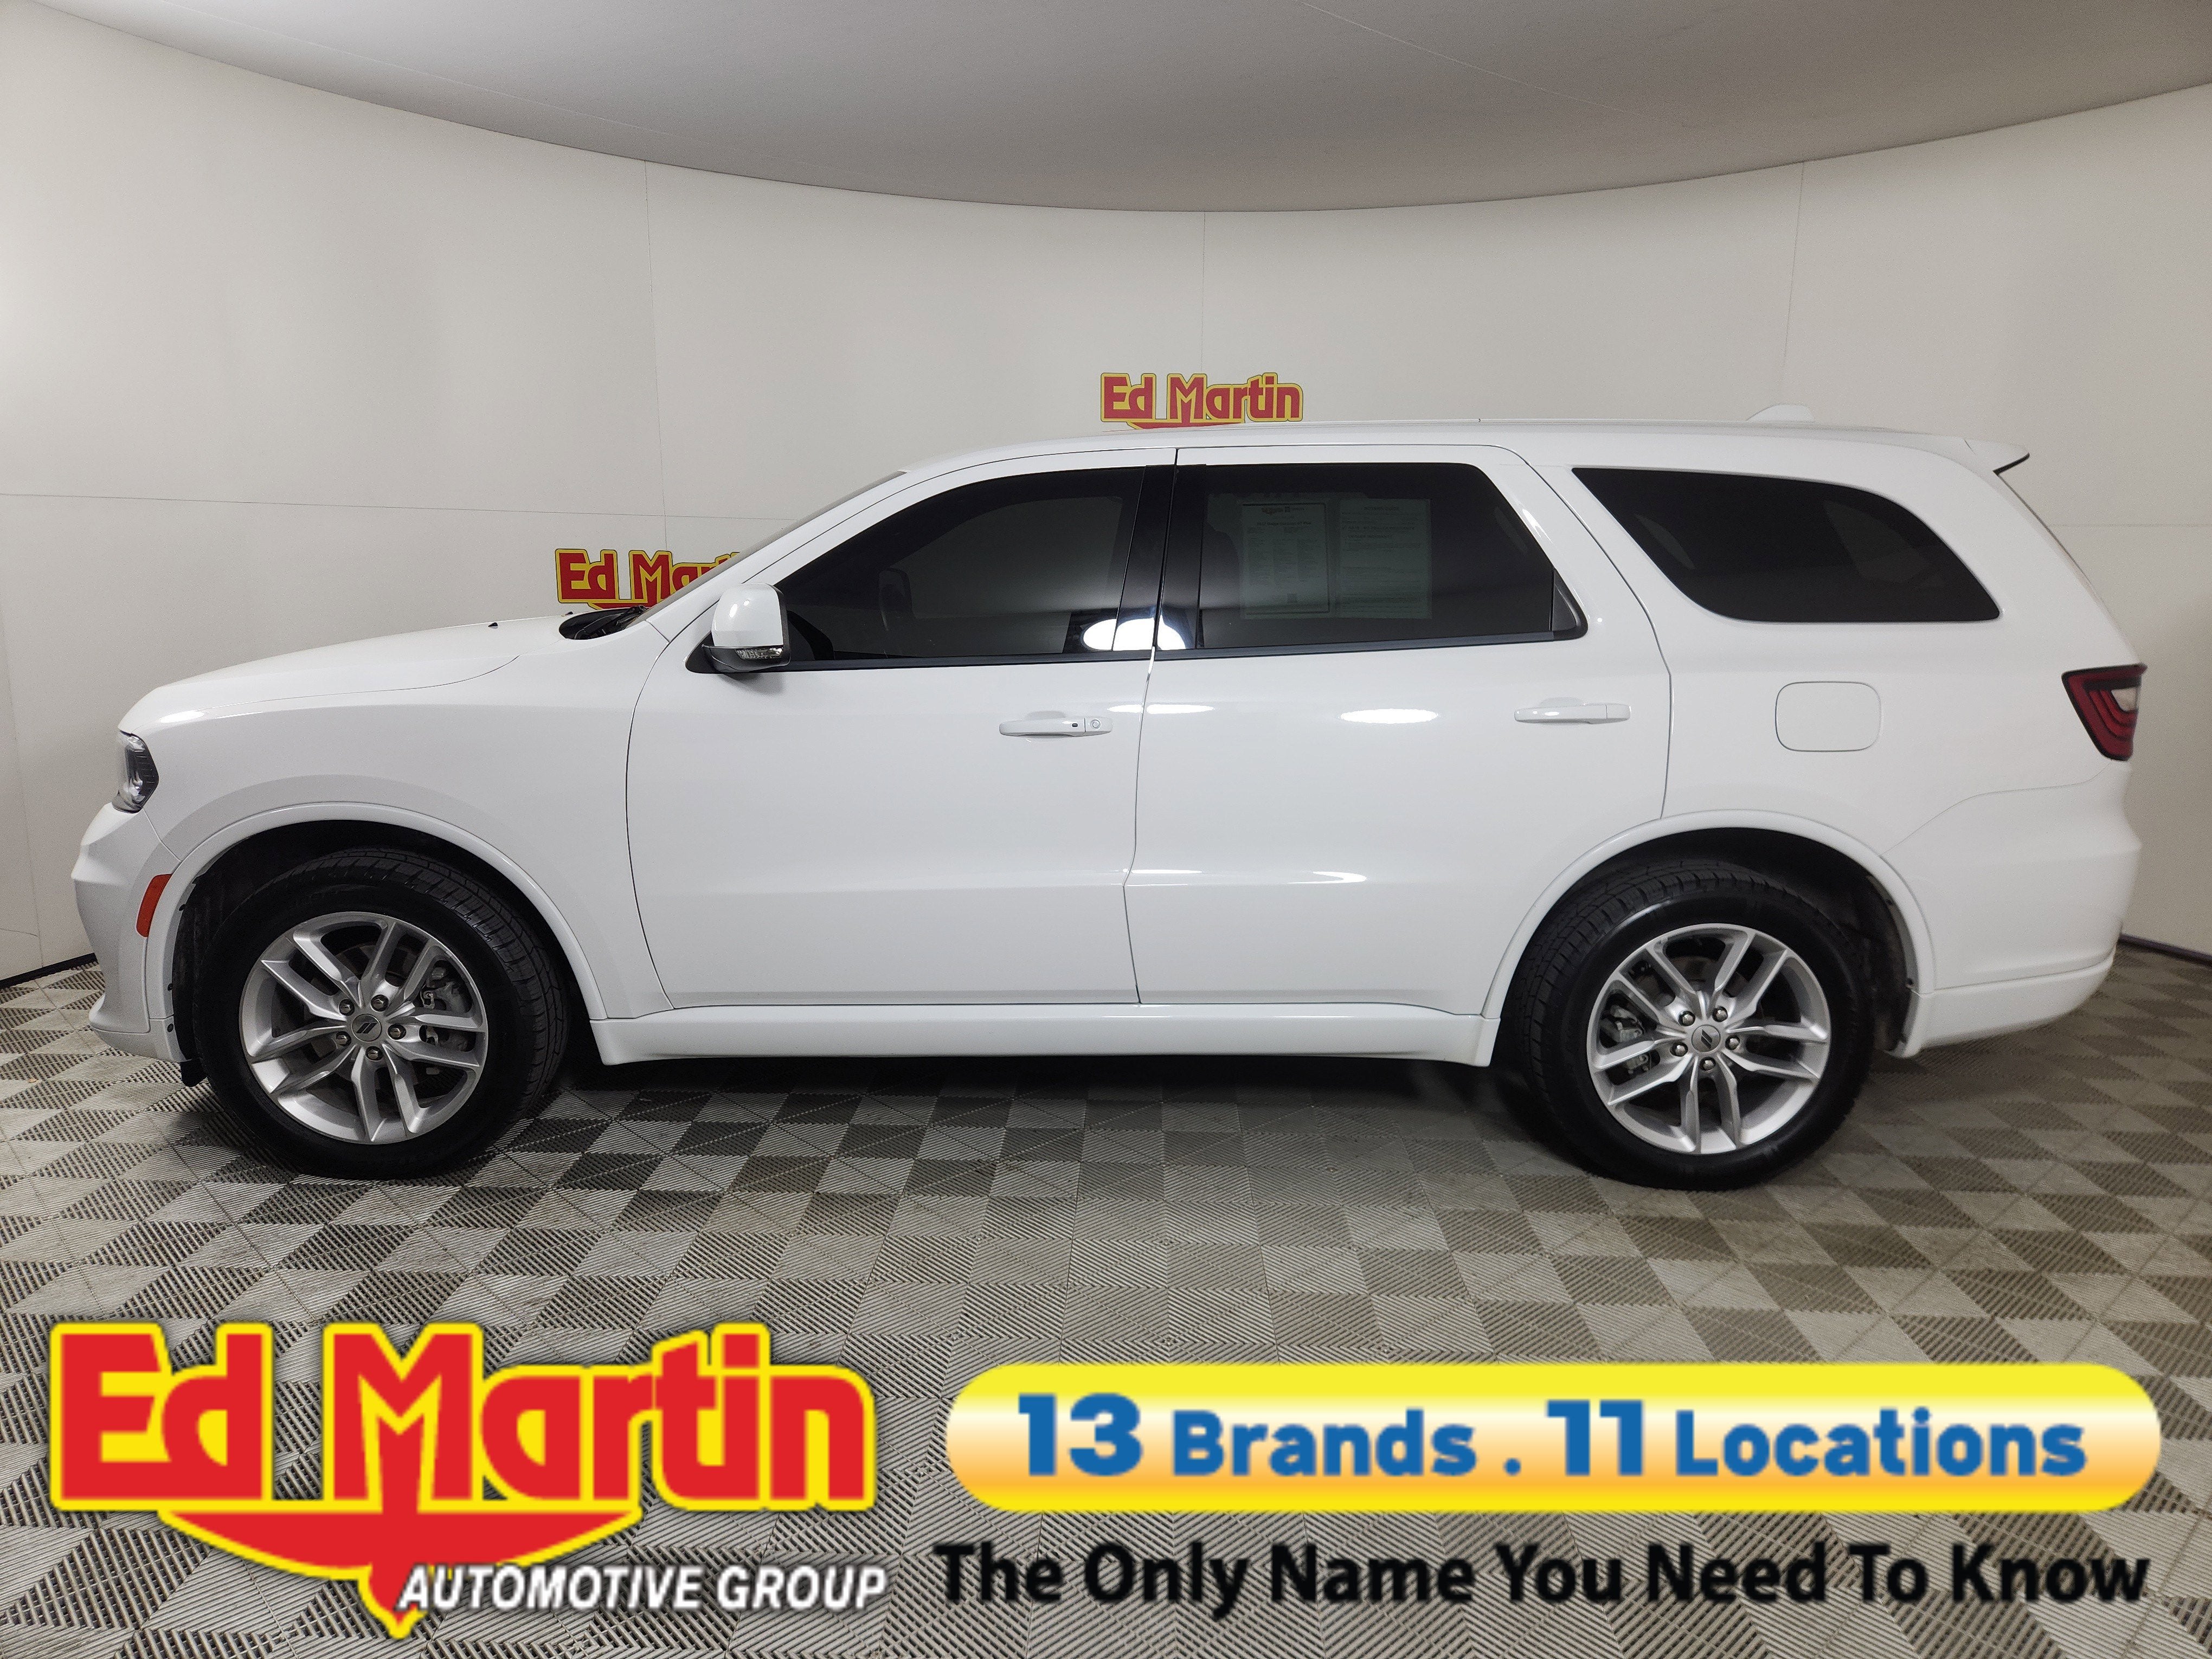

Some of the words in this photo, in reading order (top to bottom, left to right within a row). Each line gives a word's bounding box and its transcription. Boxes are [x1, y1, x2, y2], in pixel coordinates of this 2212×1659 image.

[1103, 375, 1154, 420] Ed
[1169, 375, 1301, 420] Martin
[558, 552, 617, 600] Ed
